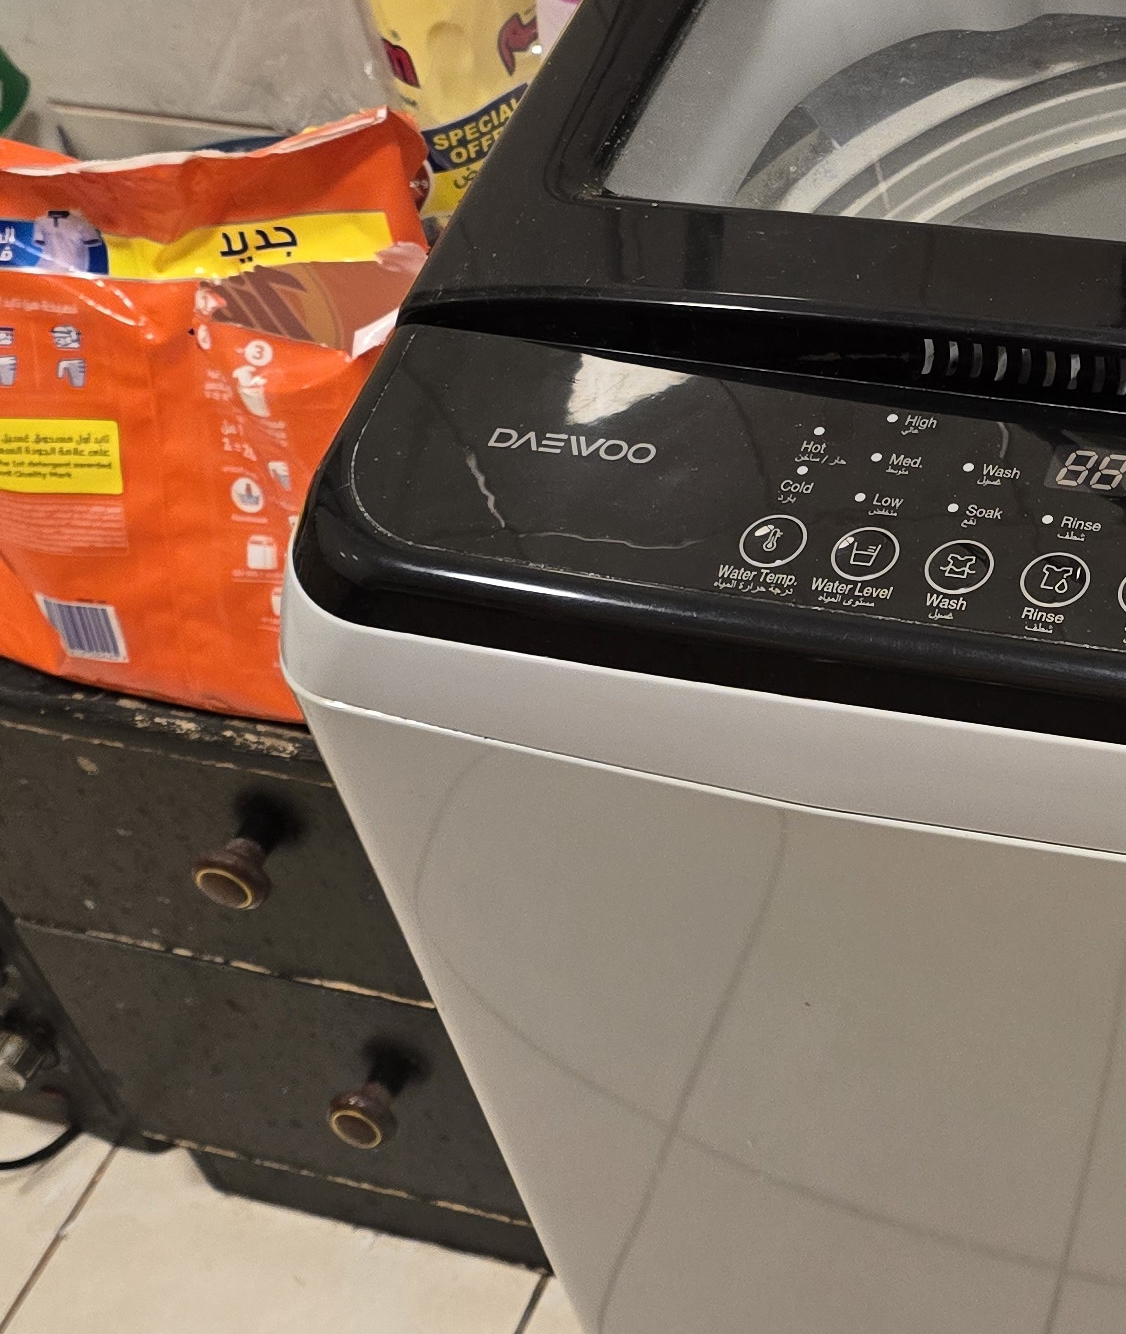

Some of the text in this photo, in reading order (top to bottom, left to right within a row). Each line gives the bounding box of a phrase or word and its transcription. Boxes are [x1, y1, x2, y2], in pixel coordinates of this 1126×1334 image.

[450, 127, 504, 163] OFF
[220, 227, 298, 263] جديد
[905, 415, 937, 429] High
[488, 428, 656, 464] DAEWOO
[801, 441, 826, 453] Hot
[889, 453, 922, 468] Med.
[983, 464, 1020, 479] Wash
[780, 480, 814, 494] Cold
[873, 493, 904, 509] Low
[965, 504, 1003, 519] Soak
[1060, 516, 1102, 532] Rinse
[718, 565, 798, 588] Water Temp.
[811, 577, 894, 600] Water Level
[925, 593, 967, 611] Wash
[1021, 607, 1064, 624] Rinse
